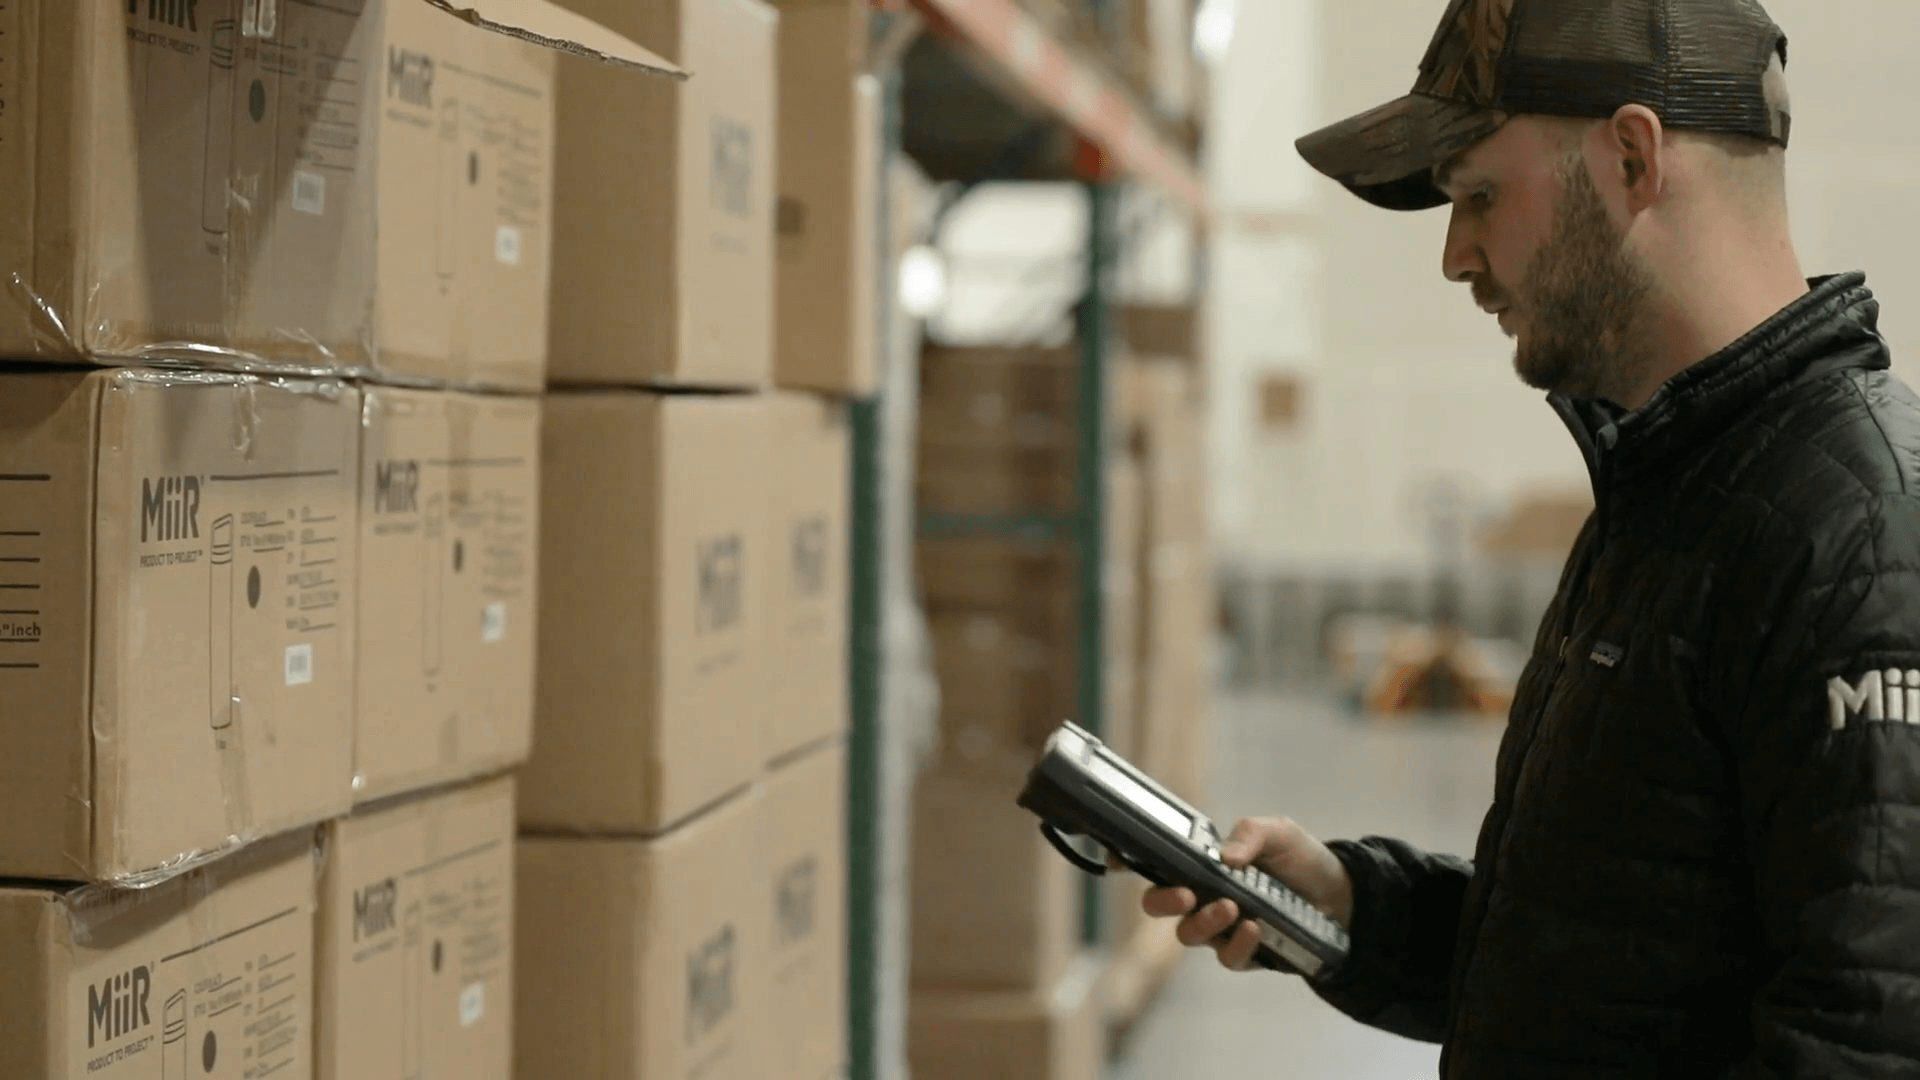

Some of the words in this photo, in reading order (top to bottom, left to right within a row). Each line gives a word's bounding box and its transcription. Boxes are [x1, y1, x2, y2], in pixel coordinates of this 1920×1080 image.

[140, 475, 200, 543] MiiR
[166, 552, 173, 565] TO
[88, 965, 151, 1050] MiiR
[115, 1048, 123, 1062] TO
